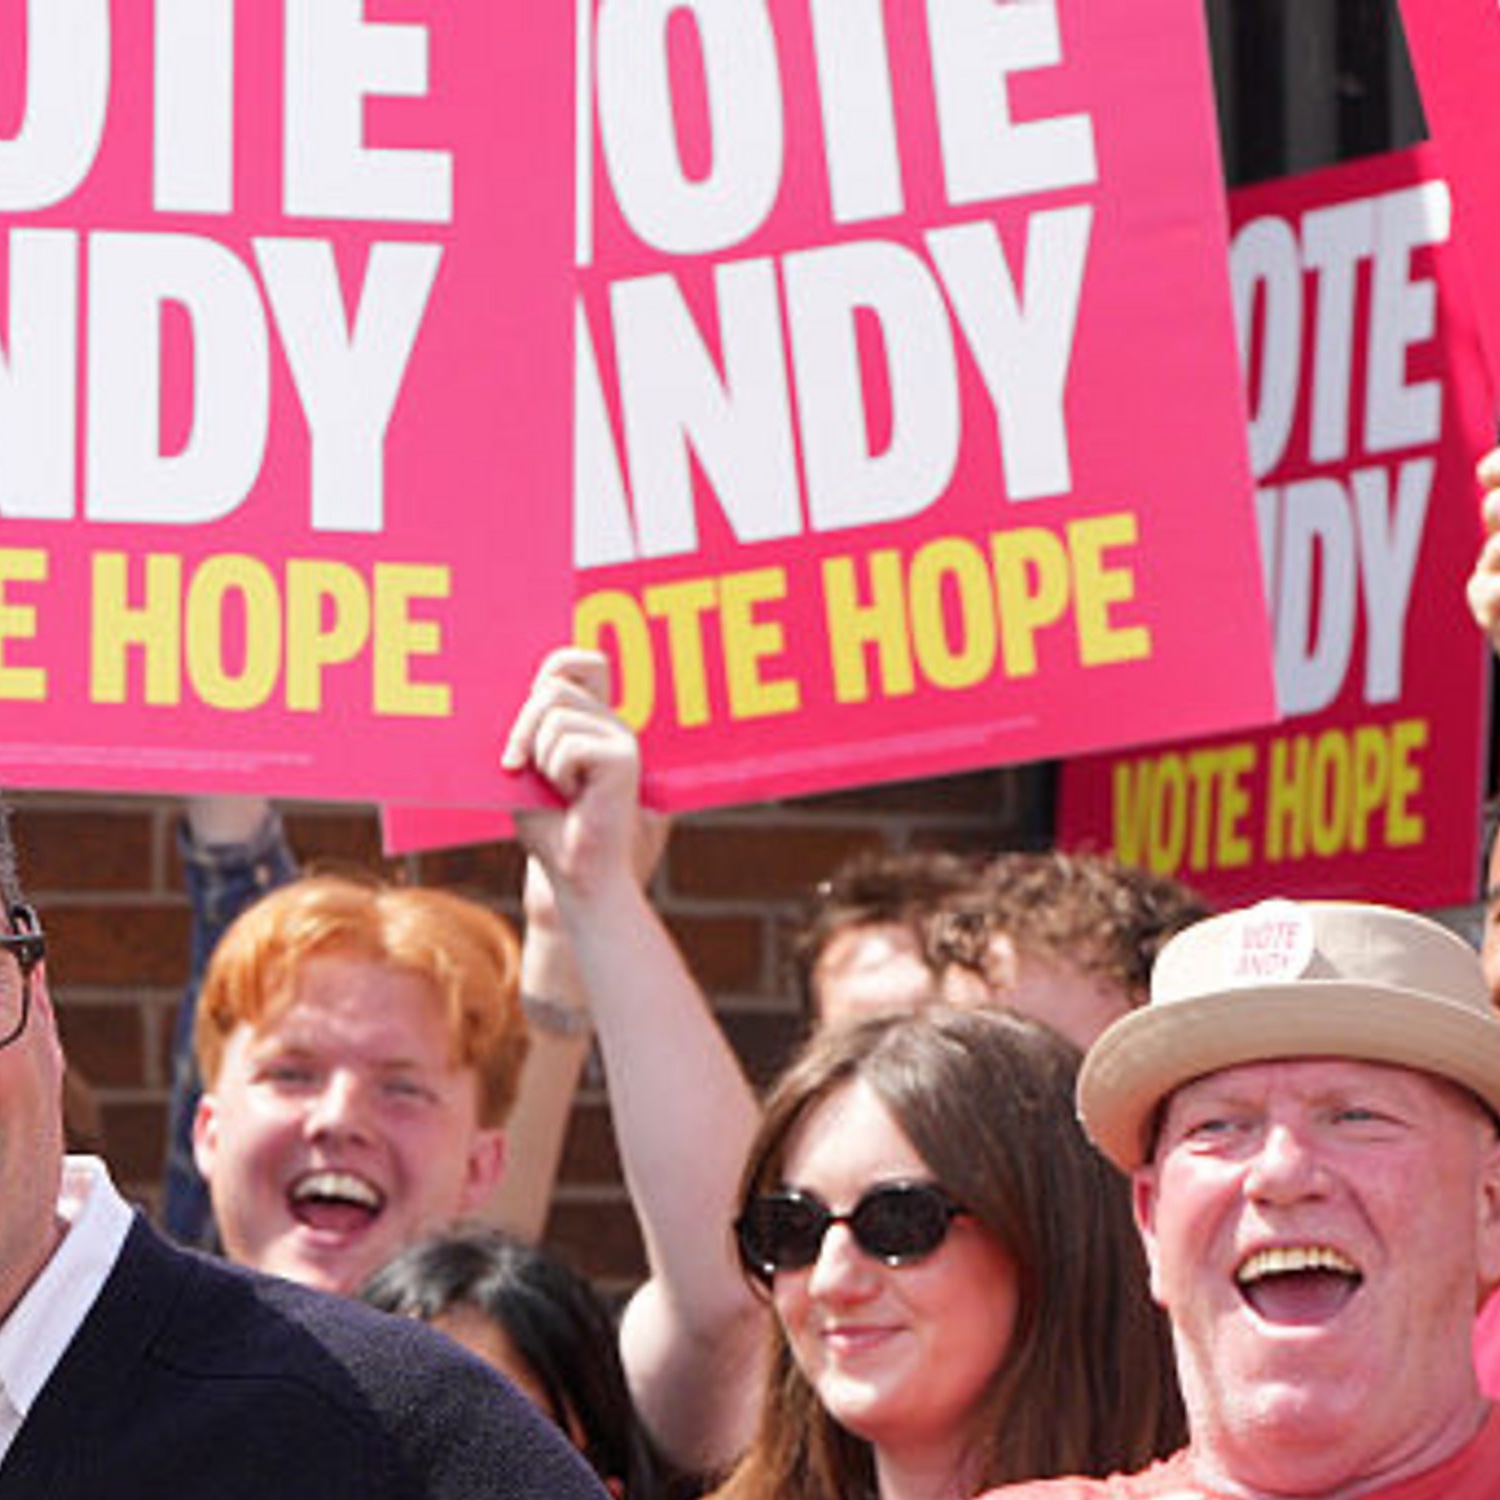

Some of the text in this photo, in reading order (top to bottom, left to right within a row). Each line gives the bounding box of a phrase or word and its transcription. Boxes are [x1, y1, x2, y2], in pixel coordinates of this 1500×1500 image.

[575, 0, 1098, 267] OTE
[1230, 180, 1451, 478] OTE
[91, 552, 451, 717] HOPE
[574, 513, 1151, 734] OTE HOPE
[1256, 456, 1436, 718] DY
[1113, 743, 1257, 875] VOTE
[1266, 719, 1427, 861] HOPE
